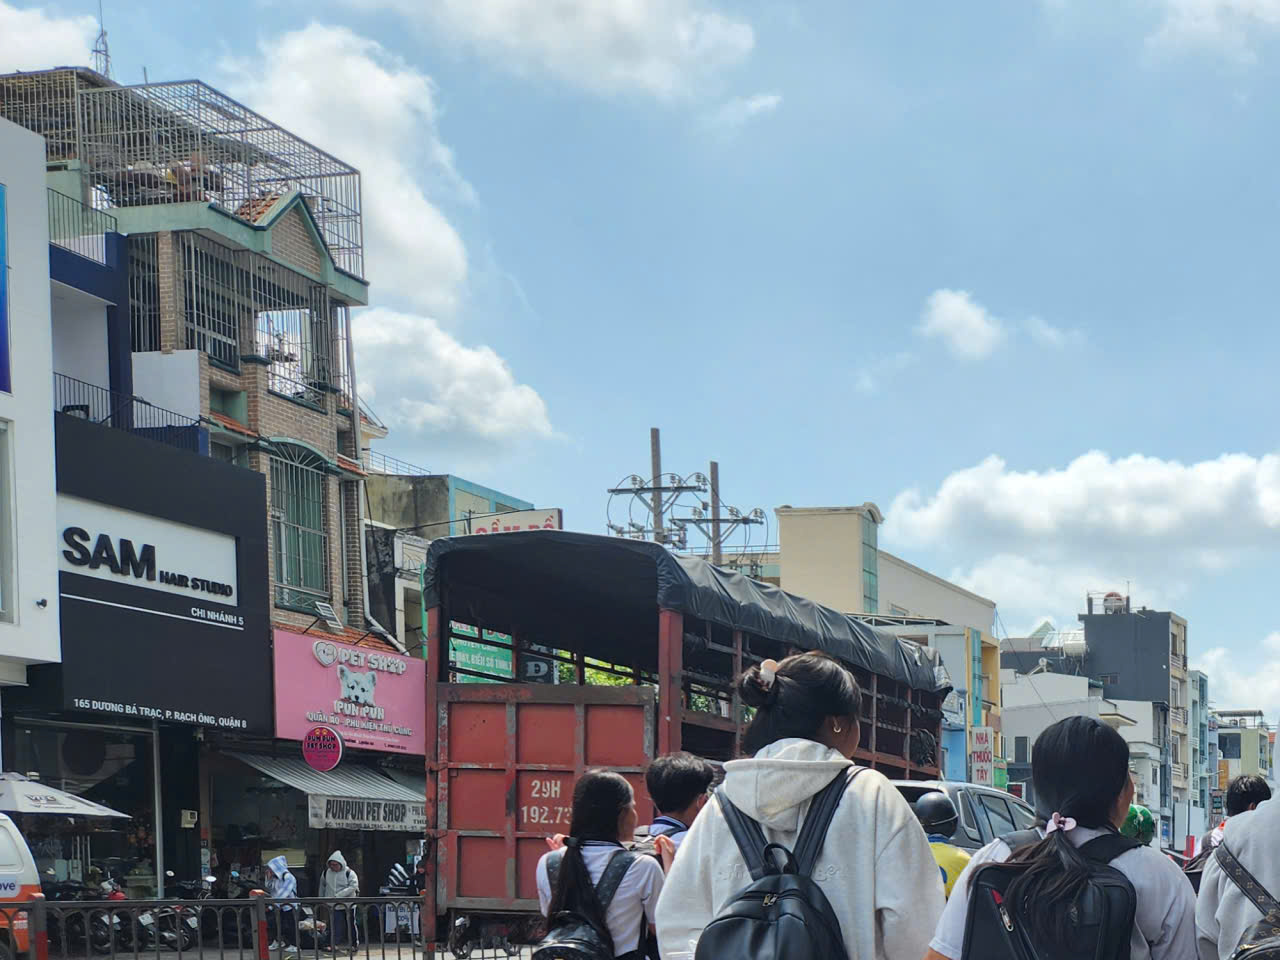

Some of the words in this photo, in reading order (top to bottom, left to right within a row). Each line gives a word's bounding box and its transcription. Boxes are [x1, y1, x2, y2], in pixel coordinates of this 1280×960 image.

[62, 527, 156, 581] SAM
[159, 570, 189, 588] HAIR
[191, 577, 233, 597] STUDIO
[191, 607, 205, 618] CHI
[207, 611, 237, 625] NHÁNH
[238, 617, 244, 625] 5
[337, 647, 366, 668] PET
[74, 699, 90, 709] 165
[92, 701, 124, 713] DƯƠNG
[126, 704, 138, 715] BÁ
[139, 707, 164, 720] TRẠC,
[166, 711, 173, 719] P.
[174, 711, 197, 722] RẠCH
[198, 713, 218, 725] ÔNG,
[219, 717, 241, 729] QUẬN
[242, 720, 247, 729] 8
[334, 700, 359, 718] PUN
[360, 704, 385, 720] PUN
[976, 729, 989, 745] NHÀ
[972, 746, 992, 763] THUỐC
[976, 766, 989, 781] TÂY
[531, 780, 560, 798] 29H
[325, 799, 365, 821] PUNPUN
[366, 801, 382, 821] PET
[383, 803, 407, 823] SHOP
